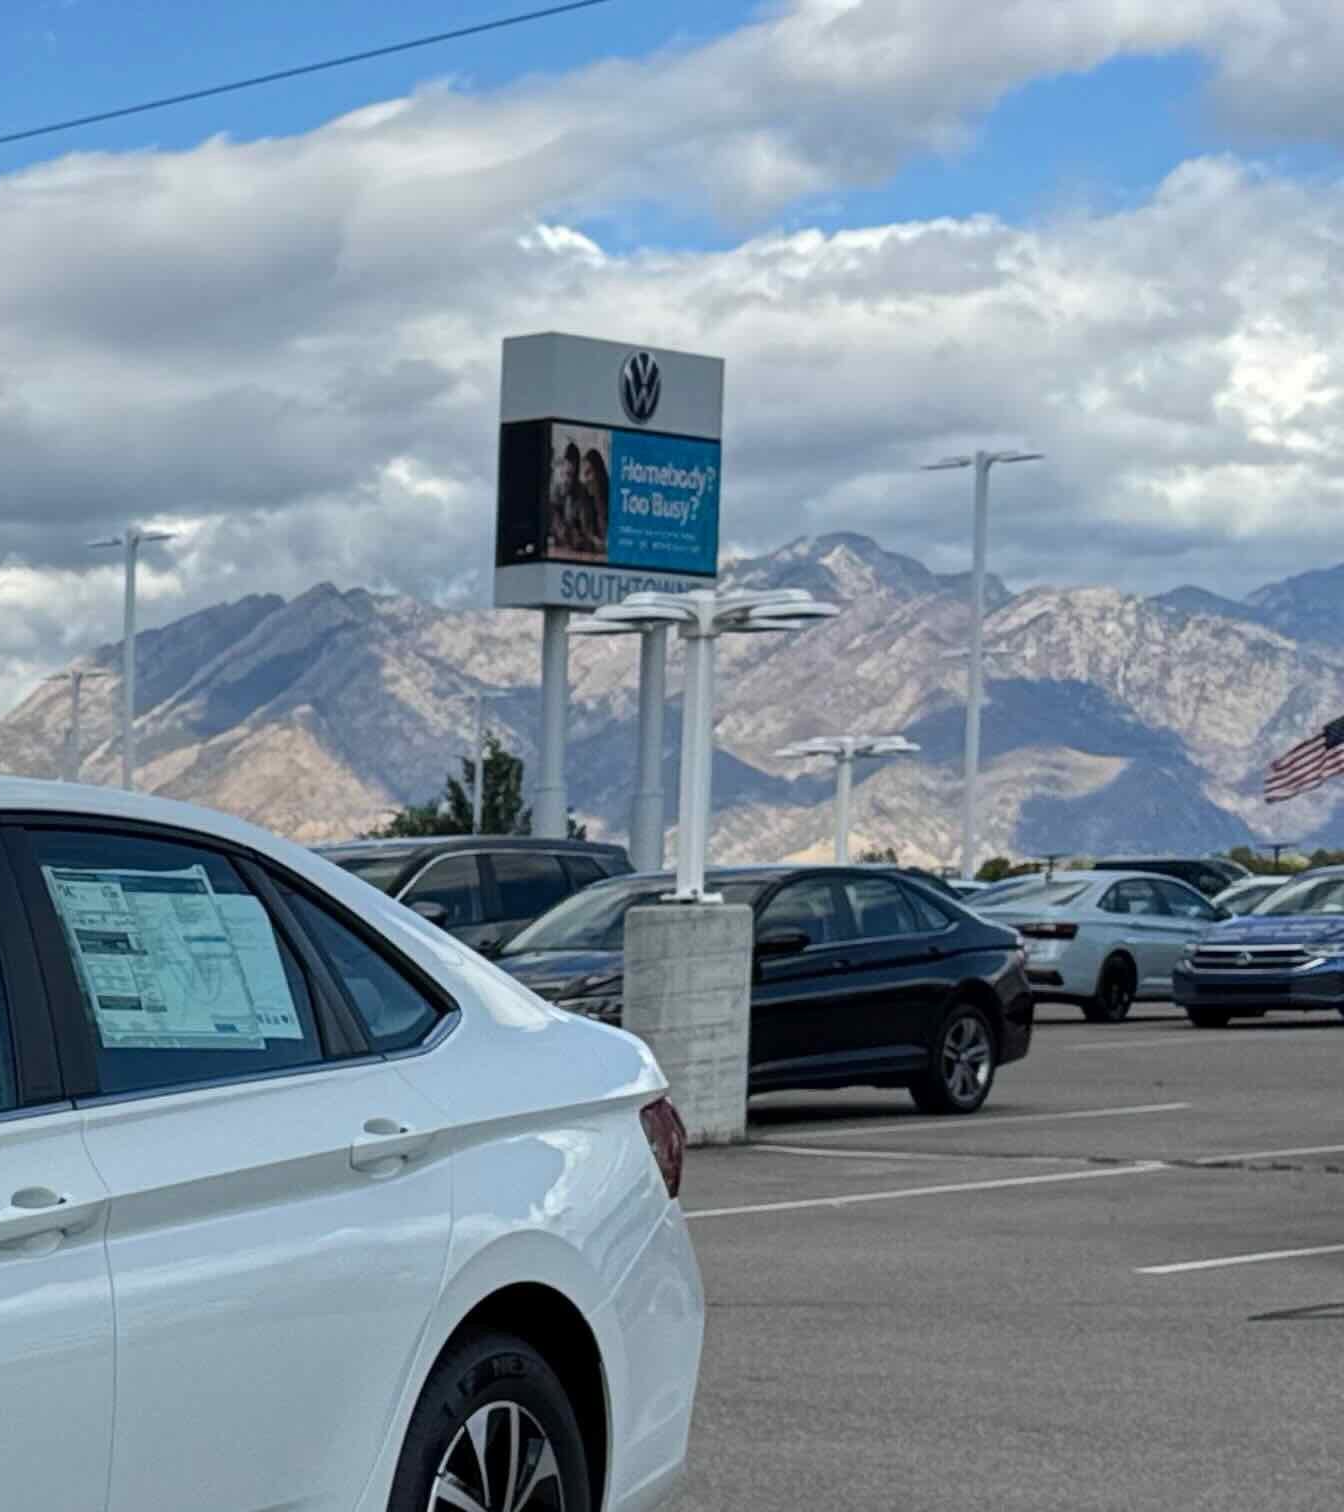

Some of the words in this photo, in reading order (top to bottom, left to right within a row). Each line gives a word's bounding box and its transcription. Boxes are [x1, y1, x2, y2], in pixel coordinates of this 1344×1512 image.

[621, 456, 716, 496] Homebody?
[620, 488, 650, 516] Too
[652, 492, 699, 527] Busy?
